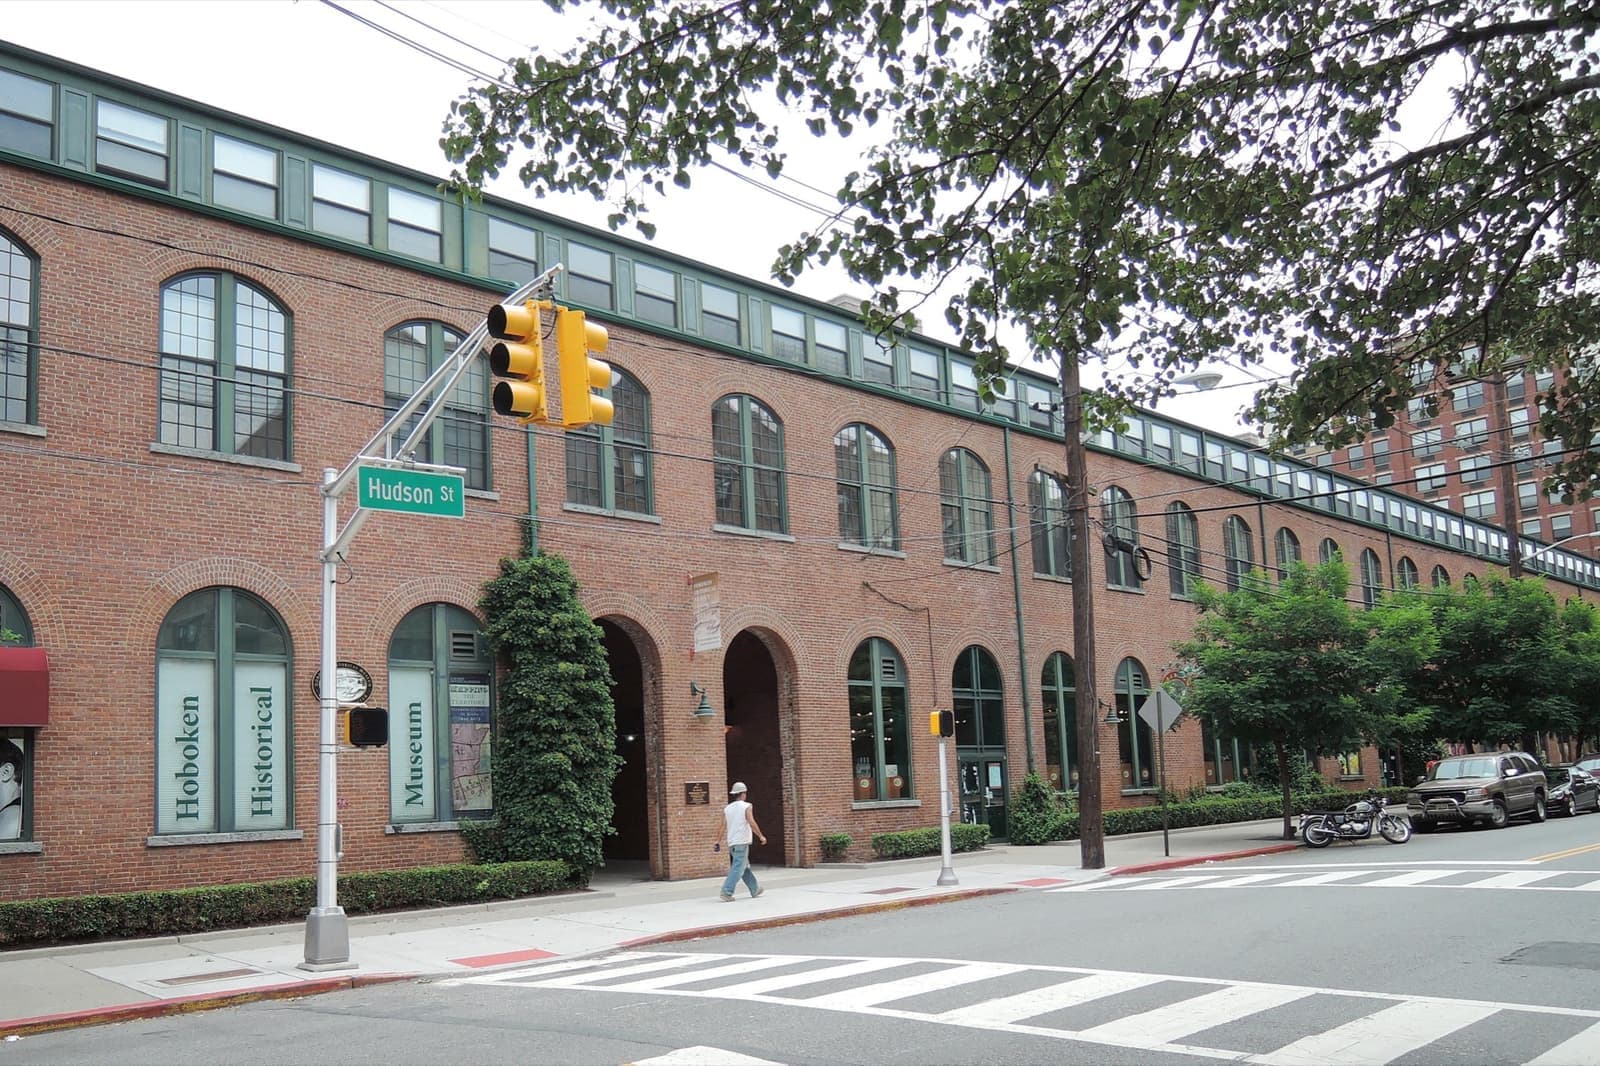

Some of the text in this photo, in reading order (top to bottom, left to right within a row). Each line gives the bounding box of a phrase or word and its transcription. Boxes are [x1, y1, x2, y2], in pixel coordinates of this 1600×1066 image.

[368, 477, 454, 505] Hudson St
[174, 695, 199, 821] Hoboken
[249, 686, 273, 817] Historical
[405, 702, 423, 807] Museum
